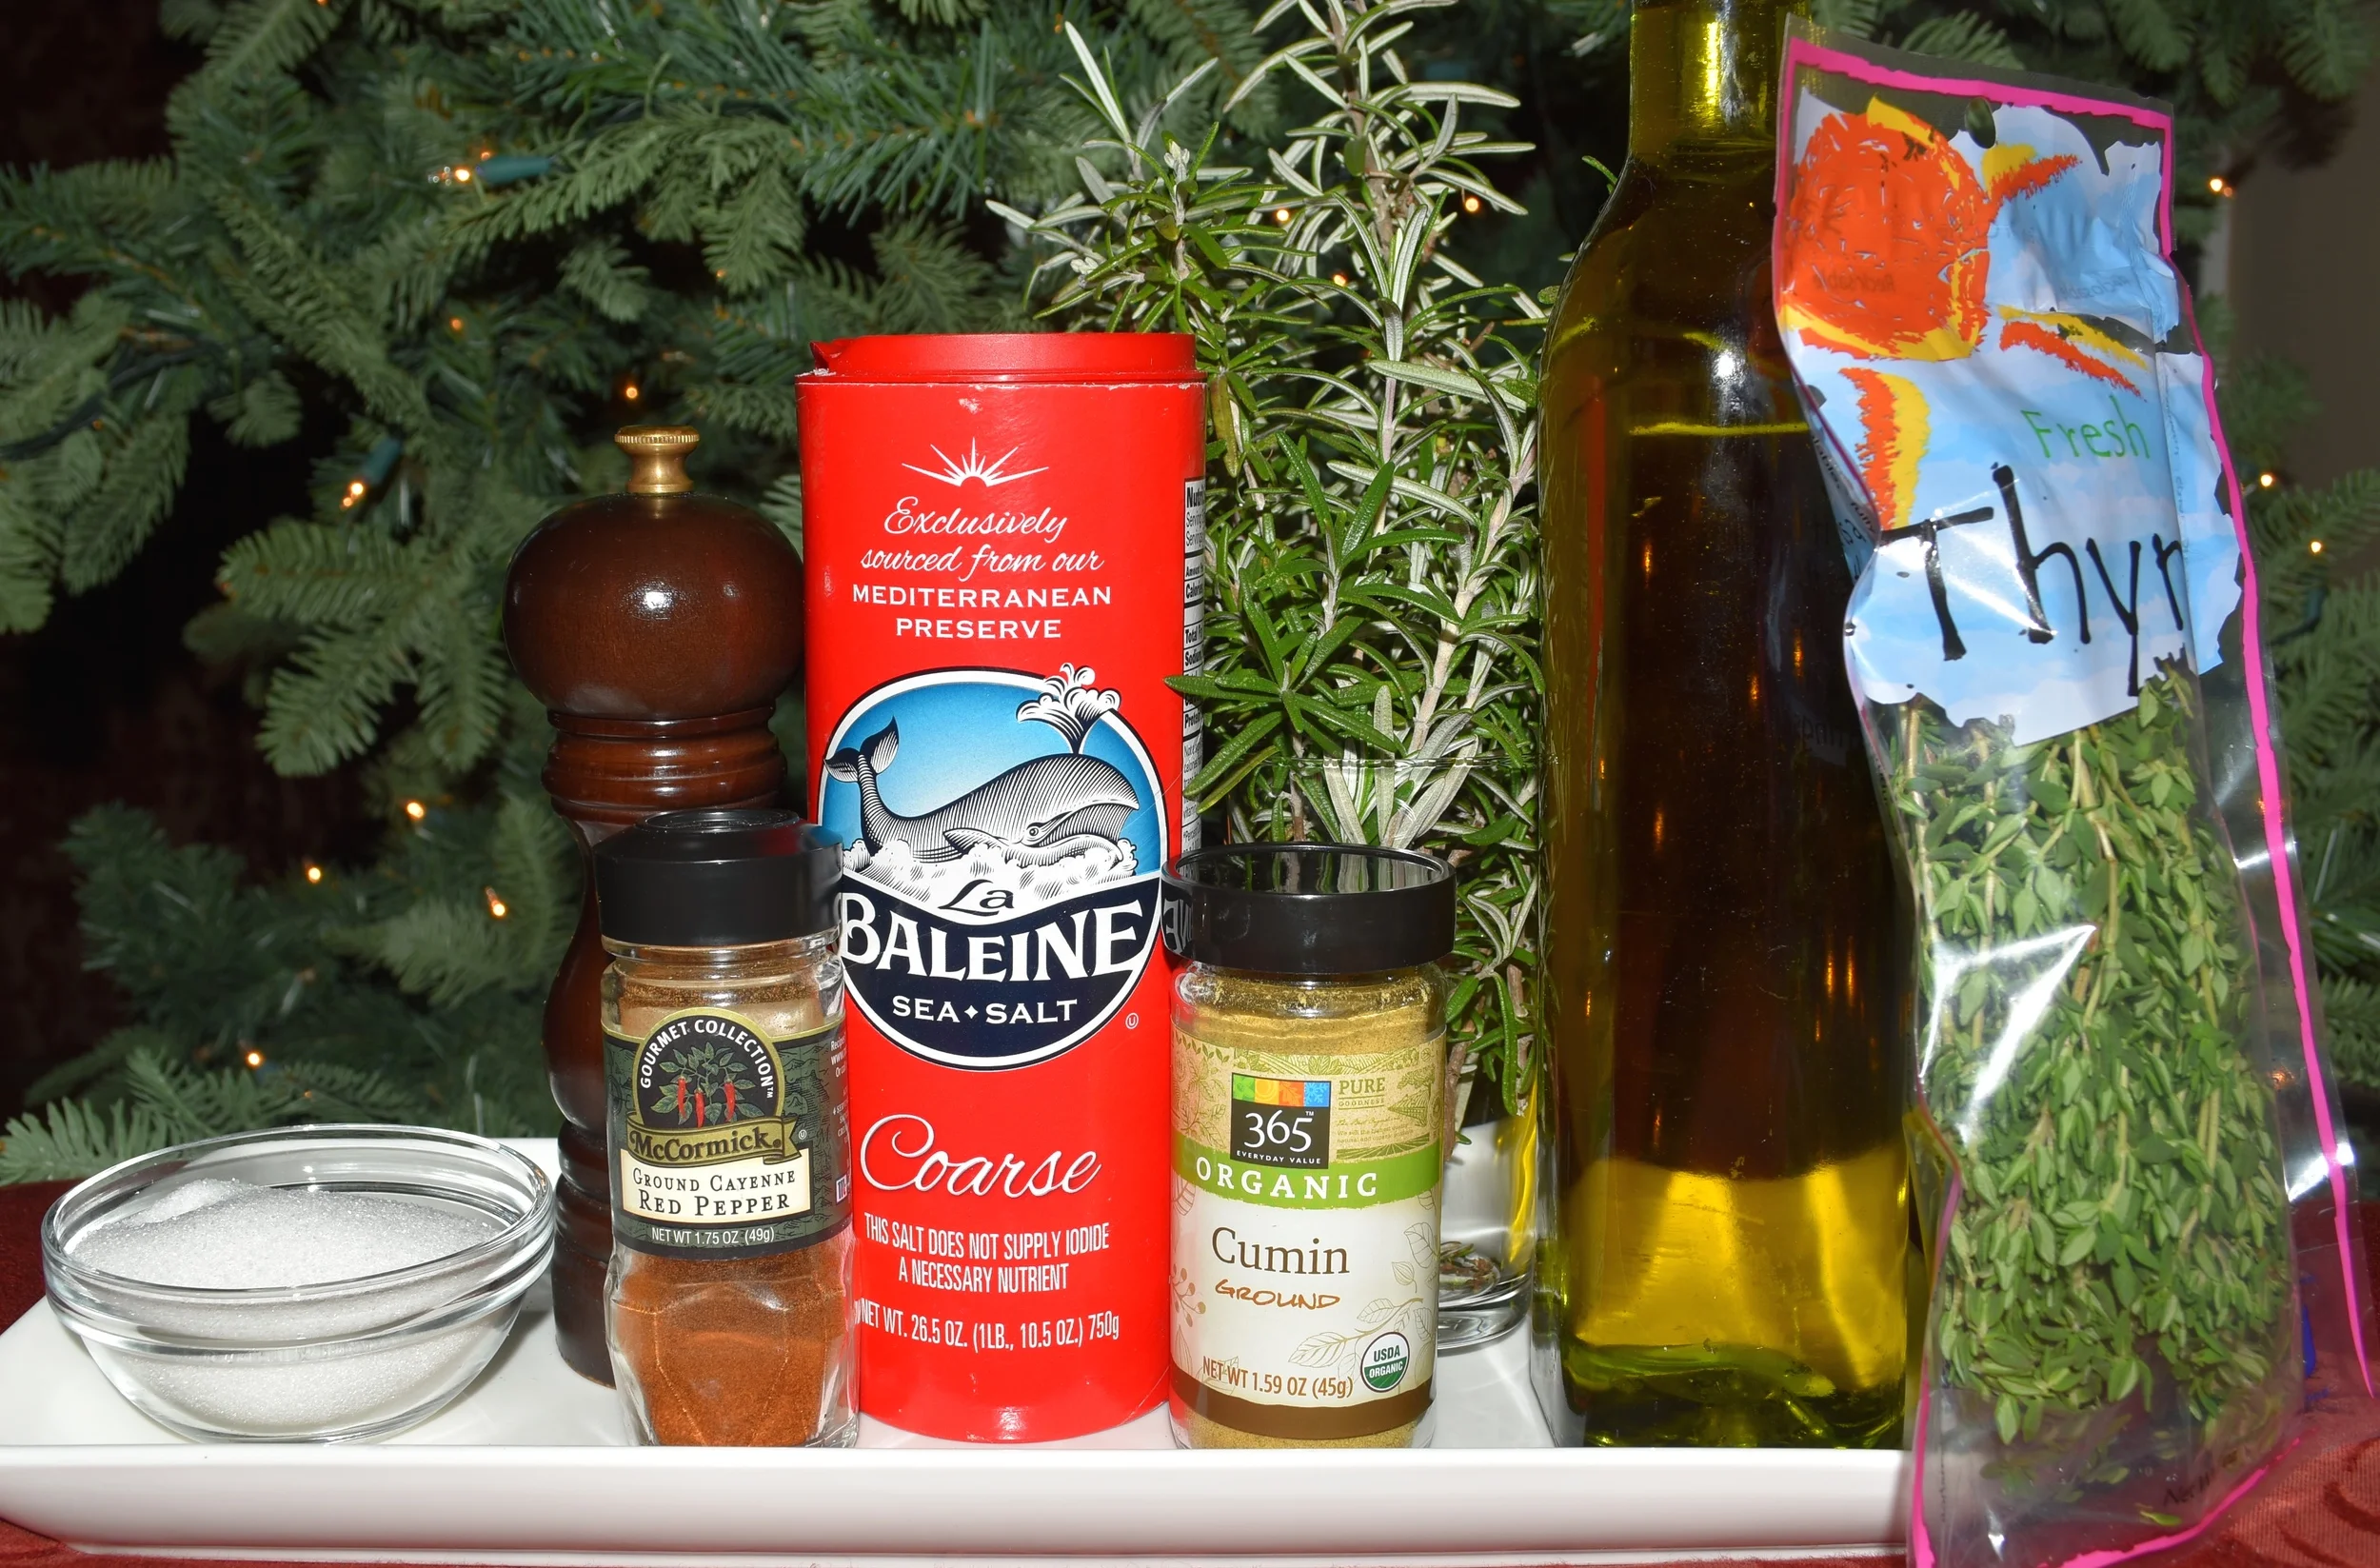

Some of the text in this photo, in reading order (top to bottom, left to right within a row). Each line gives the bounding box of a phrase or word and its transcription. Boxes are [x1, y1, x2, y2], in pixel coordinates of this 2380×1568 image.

[2021, 396, 2151, 460] Fresh
[883, 496, 1068, 544] Exclusively
[861, 544, 1104, 582] sourced from our
[852, 584, 1111, 608] MEDITERRANEAN
[896, 617, 1061, 639] PRESERVE
[939, 880, 1015, 916] La
[839, 892, 1143, 982] BALEINE
[892, 995, 1078, 1025] SEA SALT
[641, 1022, 688, 1088] GOURMET
[694, 1019, 774, 1087] COLLECTION
[1339, 1077, 1386, 1095] PURE
[1339, 1098, 1384, 1107] GOODNESS
[629, 1127, 770, 1161] McCormick
[1243, 1109, 1314, 1153] 365
[860, 1114, 1101, 1198] Coarse
[1237, 1150, 1284, 1163] EVERYDAY
[633, 1167, 796, 1192] GROUND CAYENNE
[1196, 1157, 1378, 1200] ORGANIC
[639, 1189, 789, 1217] RED PEPPER
[652, 1226, 775, 1244] NET WT 1.75 OZ (49g)
[864, 1212, 1109, 1260] THIS SALT DOES NOT SUPPLY IODIDE
[1212, 1226, 1350, 1275] Cumin
[898, 1257, 1069, 1294] A NECESSARY NUTRIENT
[1215, 1279, 1340, 1310] GROUND
[861, 1298, 881, 1327] NET
[883, 1307, 907, 1338] WT.
[911, 1315, 941, 1343] 26.5
[944, 1320, 968, 1347] OZ.
[1020, 1321, 1051, 1348] 10.5
[1056, 1316, 1083, 1347] OZ.)
[1088, 1310, 1120, 1341] 750g
[1369, 1360, 1403, 1379] ORGANIC
[1373, 1344, 1400, 1362] USDA
[1203, 1356, 1353, 1399] NET WT 1.59 OZ (45g)
